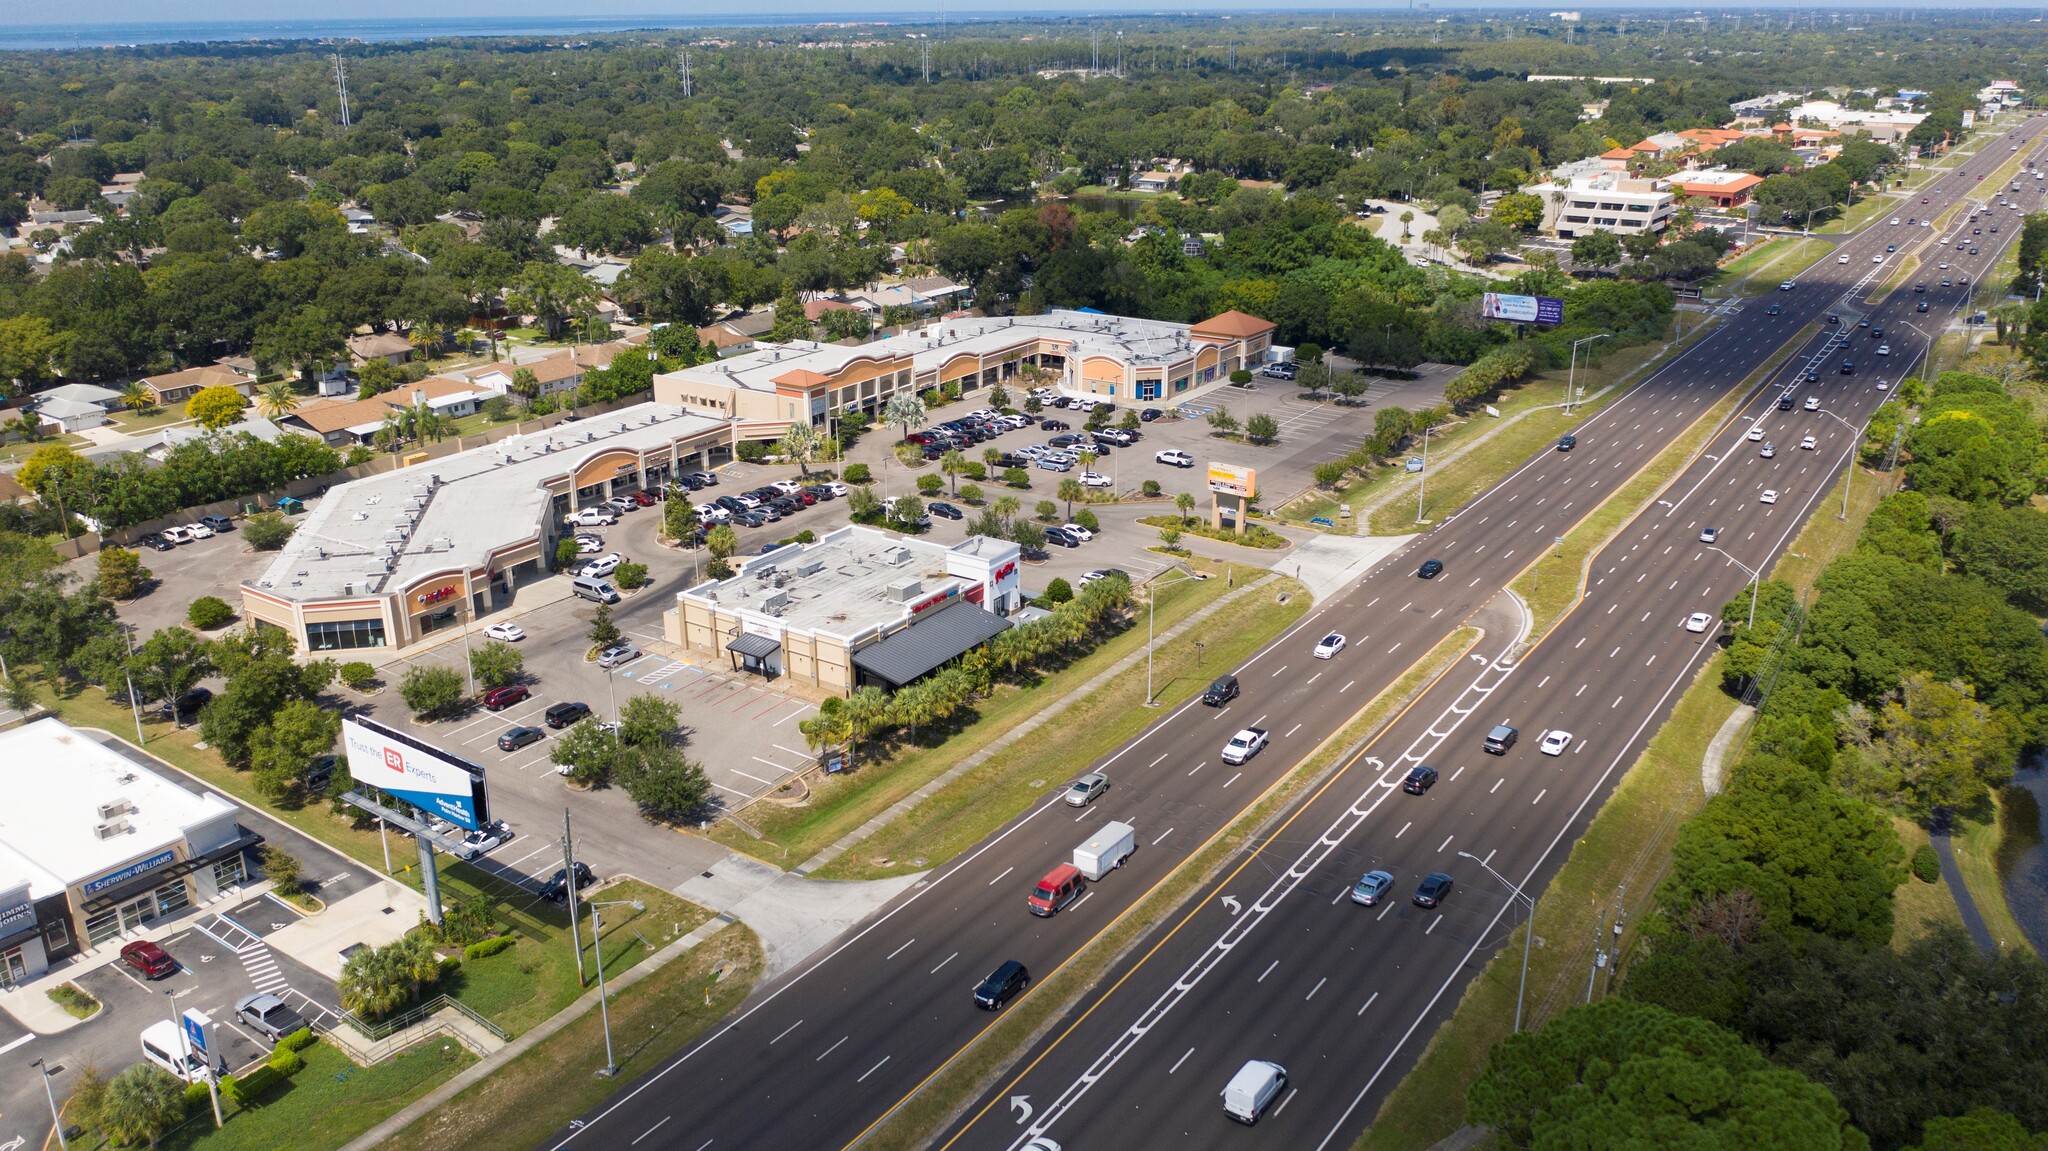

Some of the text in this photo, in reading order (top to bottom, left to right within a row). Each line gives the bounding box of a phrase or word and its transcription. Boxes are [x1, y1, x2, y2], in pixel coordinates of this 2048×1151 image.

[425, 585, 457, 603] RE/MAX
[349, 737, 437, 784] Trust the ER Experts
[436, 797, 470, 818] AdventHealth
